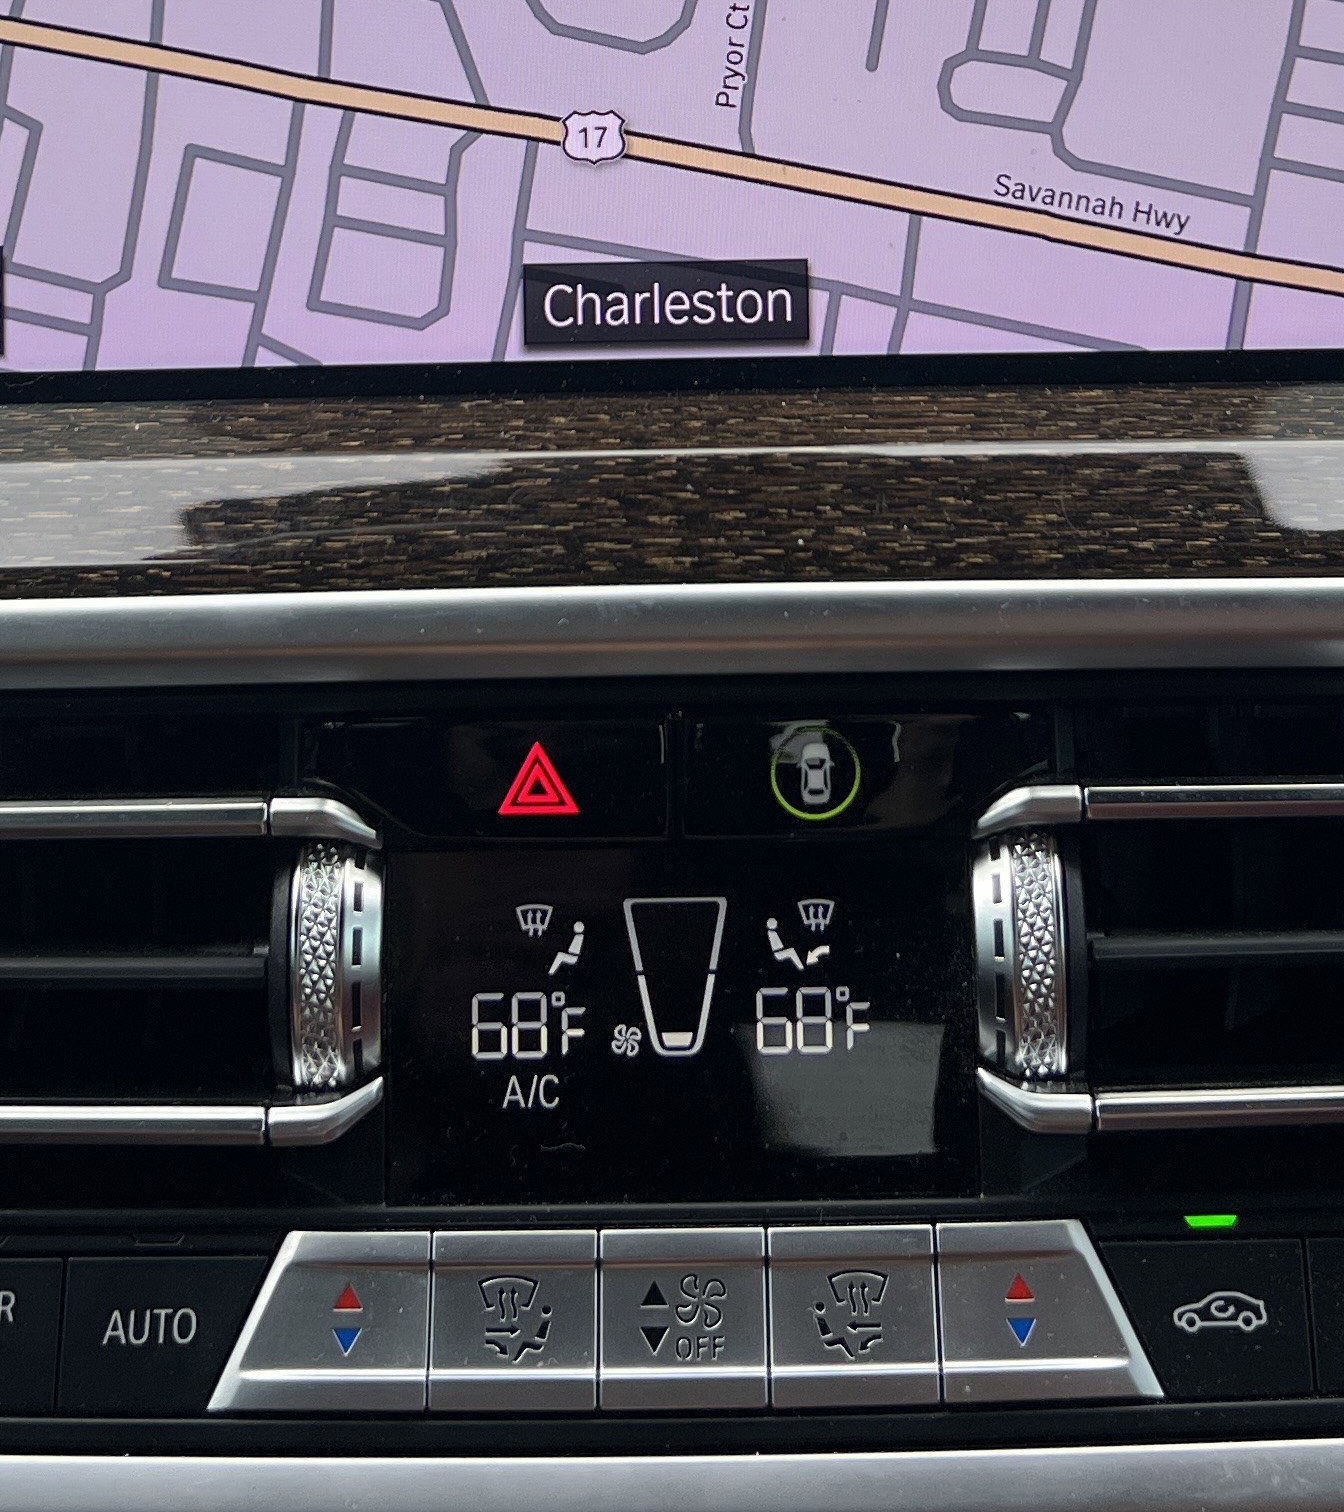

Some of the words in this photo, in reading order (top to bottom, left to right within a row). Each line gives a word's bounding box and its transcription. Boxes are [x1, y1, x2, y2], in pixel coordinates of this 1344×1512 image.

[726, 3, 750, 30] Ct
[715, 36, 746, 108] Pryor
[578, 126, 609, 150] 17
[993, 174, 1124, 219] Savannah
[1132, 201, 1191, 236] Hwy
[544, 282, 793, 327] Charleston
[502, 1074, 560, 1109] A/C
[102, 1307, 197, 1345] AUTO
[675, 1335, 725, 1361] OFF
